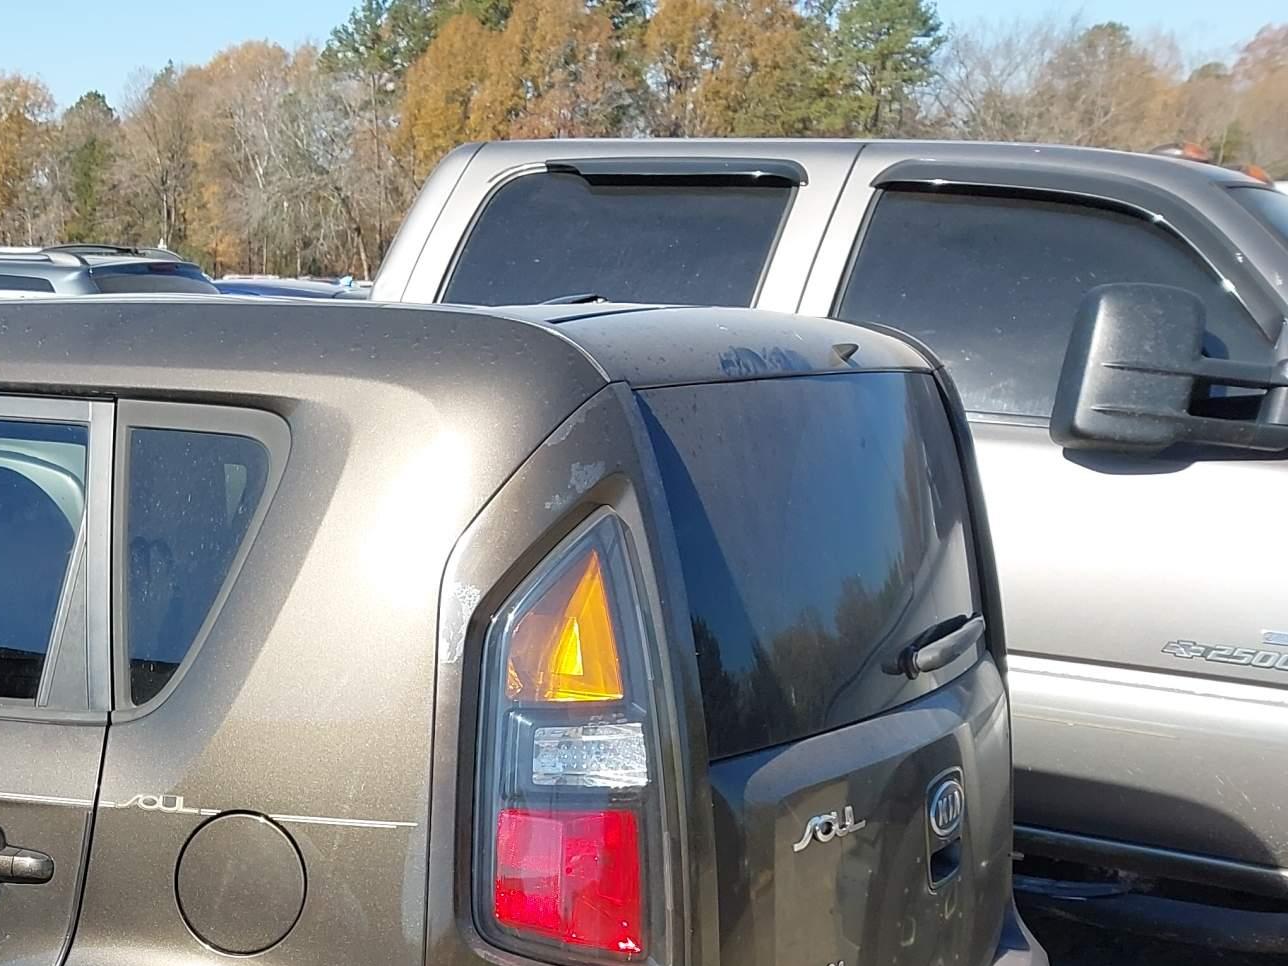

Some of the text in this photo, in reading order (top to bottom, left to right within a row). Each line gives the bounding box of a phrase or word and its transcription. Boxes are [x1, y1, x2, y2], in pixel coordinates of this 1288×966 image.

[116, 794, 199, 813] SOUL
[938, 790, 961, 827] KIA
[793, 805, 866, 852] SOUL
